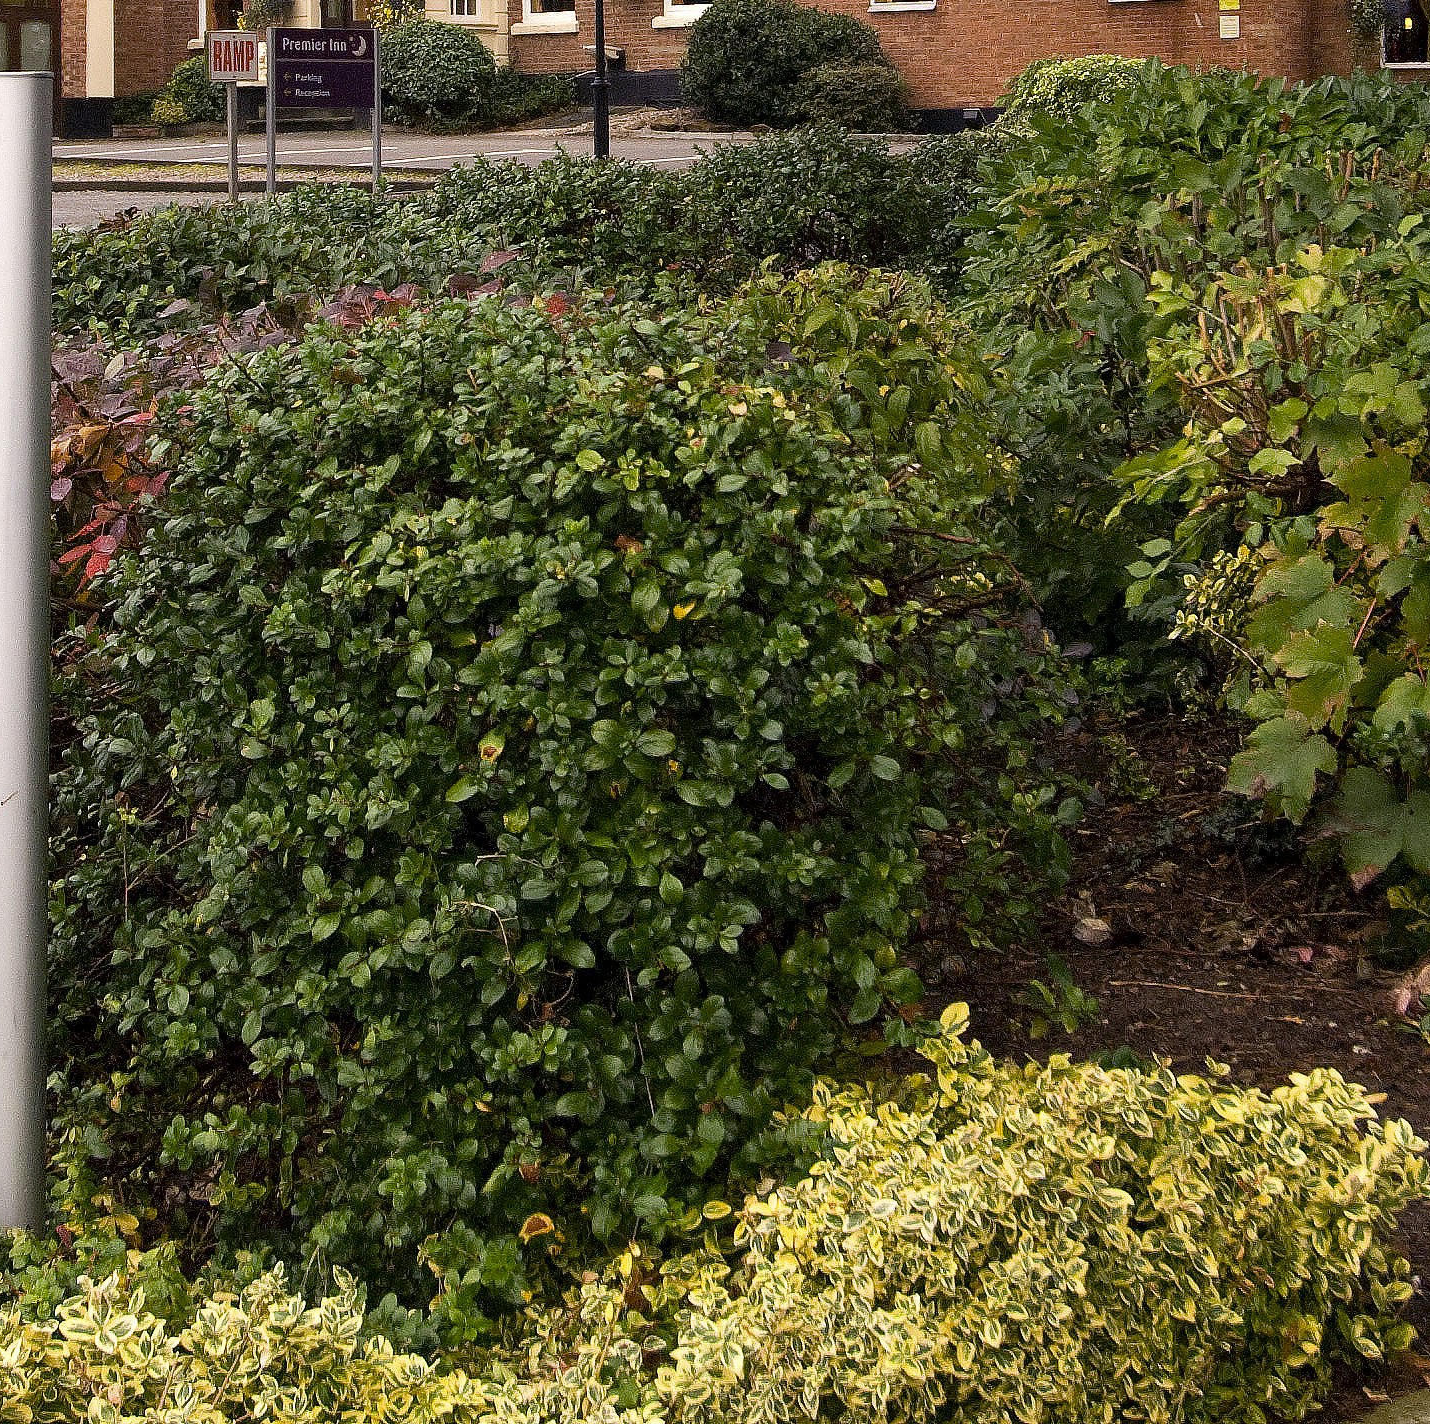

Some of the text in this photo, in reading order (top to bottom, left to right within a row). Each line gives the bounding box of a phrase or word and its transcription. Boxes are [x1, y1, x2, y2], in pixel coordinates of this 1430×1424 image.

[282, 37, 347, 52] Premier Inn
[213, 40, 255, 72] RAMP
[295, 73, 322, 84] Parking
[295, 88, 331, 98] Reception
